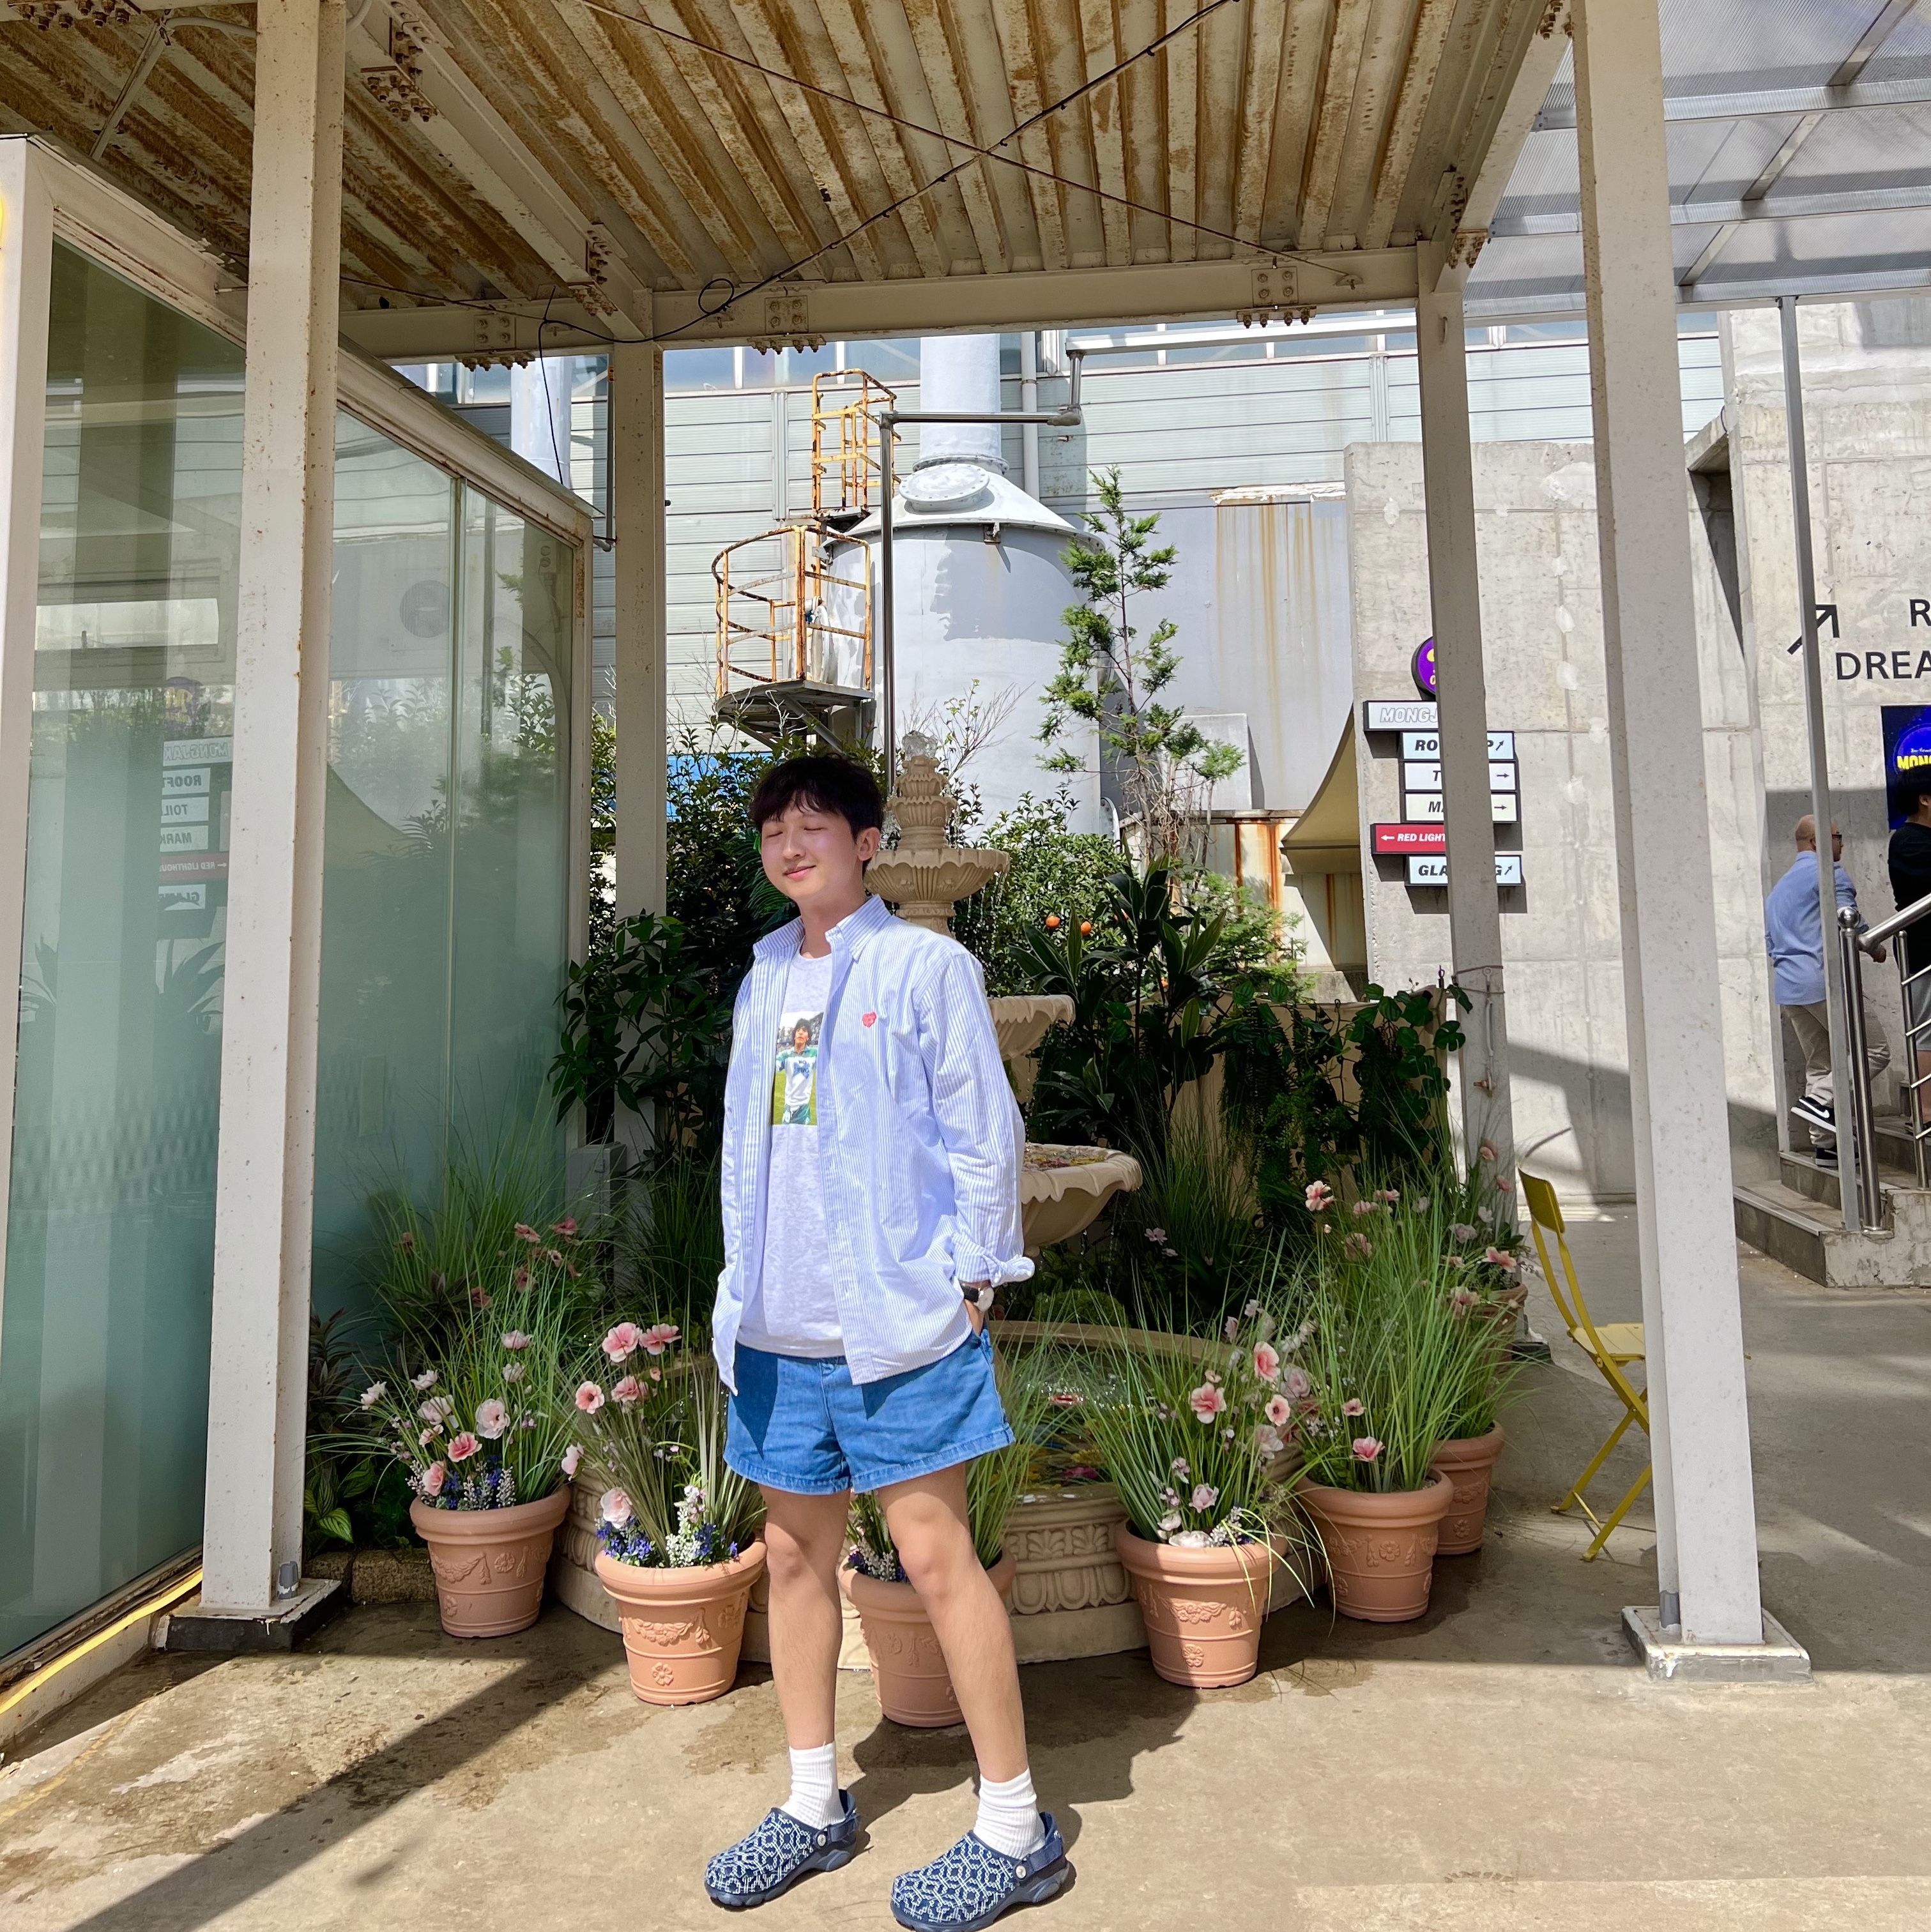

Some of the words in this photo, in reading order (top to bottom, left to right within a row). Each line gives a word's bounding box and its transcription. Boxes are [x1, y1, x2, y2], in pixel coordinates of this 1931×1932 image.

[1836, 650, 1931, 680] DREA
[1380, 707, 1439, 723] MONGJ
[1397, 833, 1417, 842] RED
[1419, 833, 1446, 842] LIGHT
